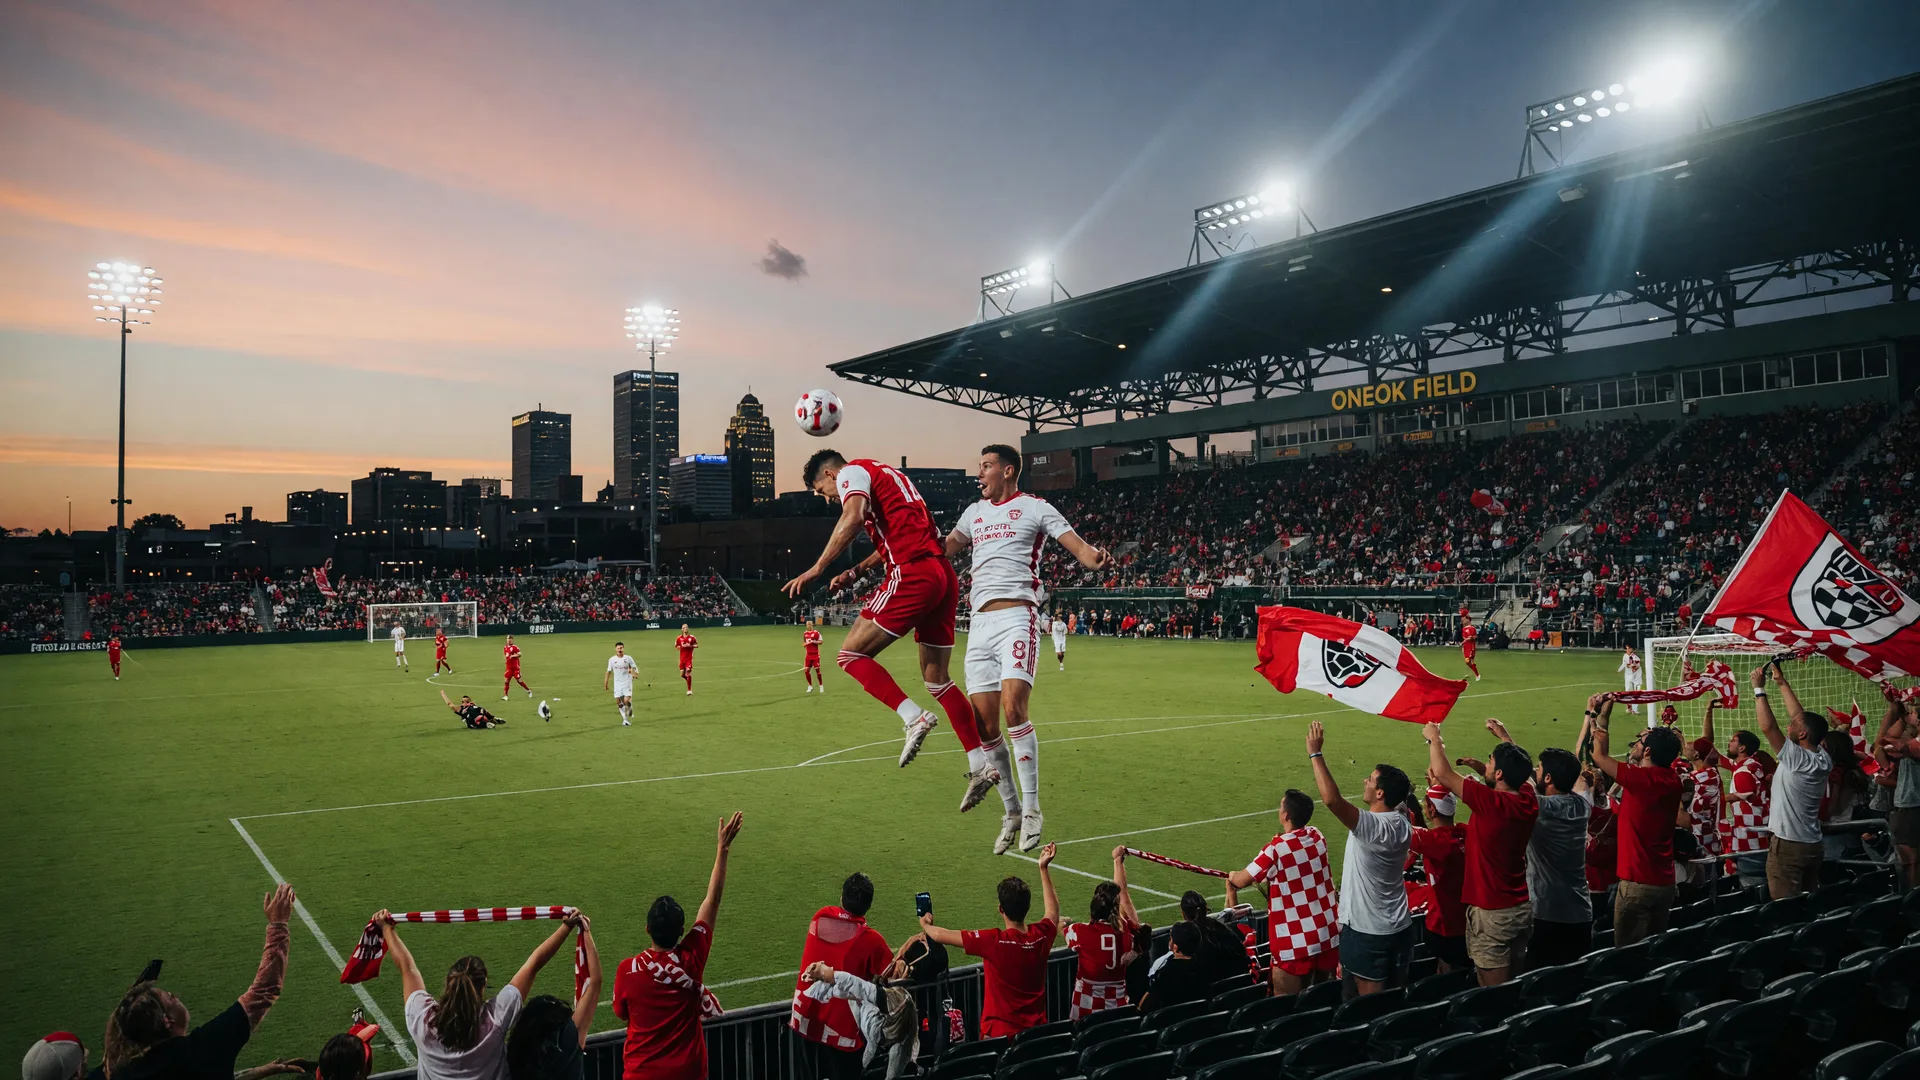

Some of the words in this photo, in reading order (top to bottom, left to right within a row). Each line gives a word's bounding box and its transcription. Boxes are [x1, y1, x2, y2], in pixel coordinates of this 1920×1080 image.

[1331, 380, 1407, 411] ONEOK
[1413, 371, 1477, 400] FIELD
[1012, 640, 1026, 660] 8
[1100, 933, 1117, 970] 9
